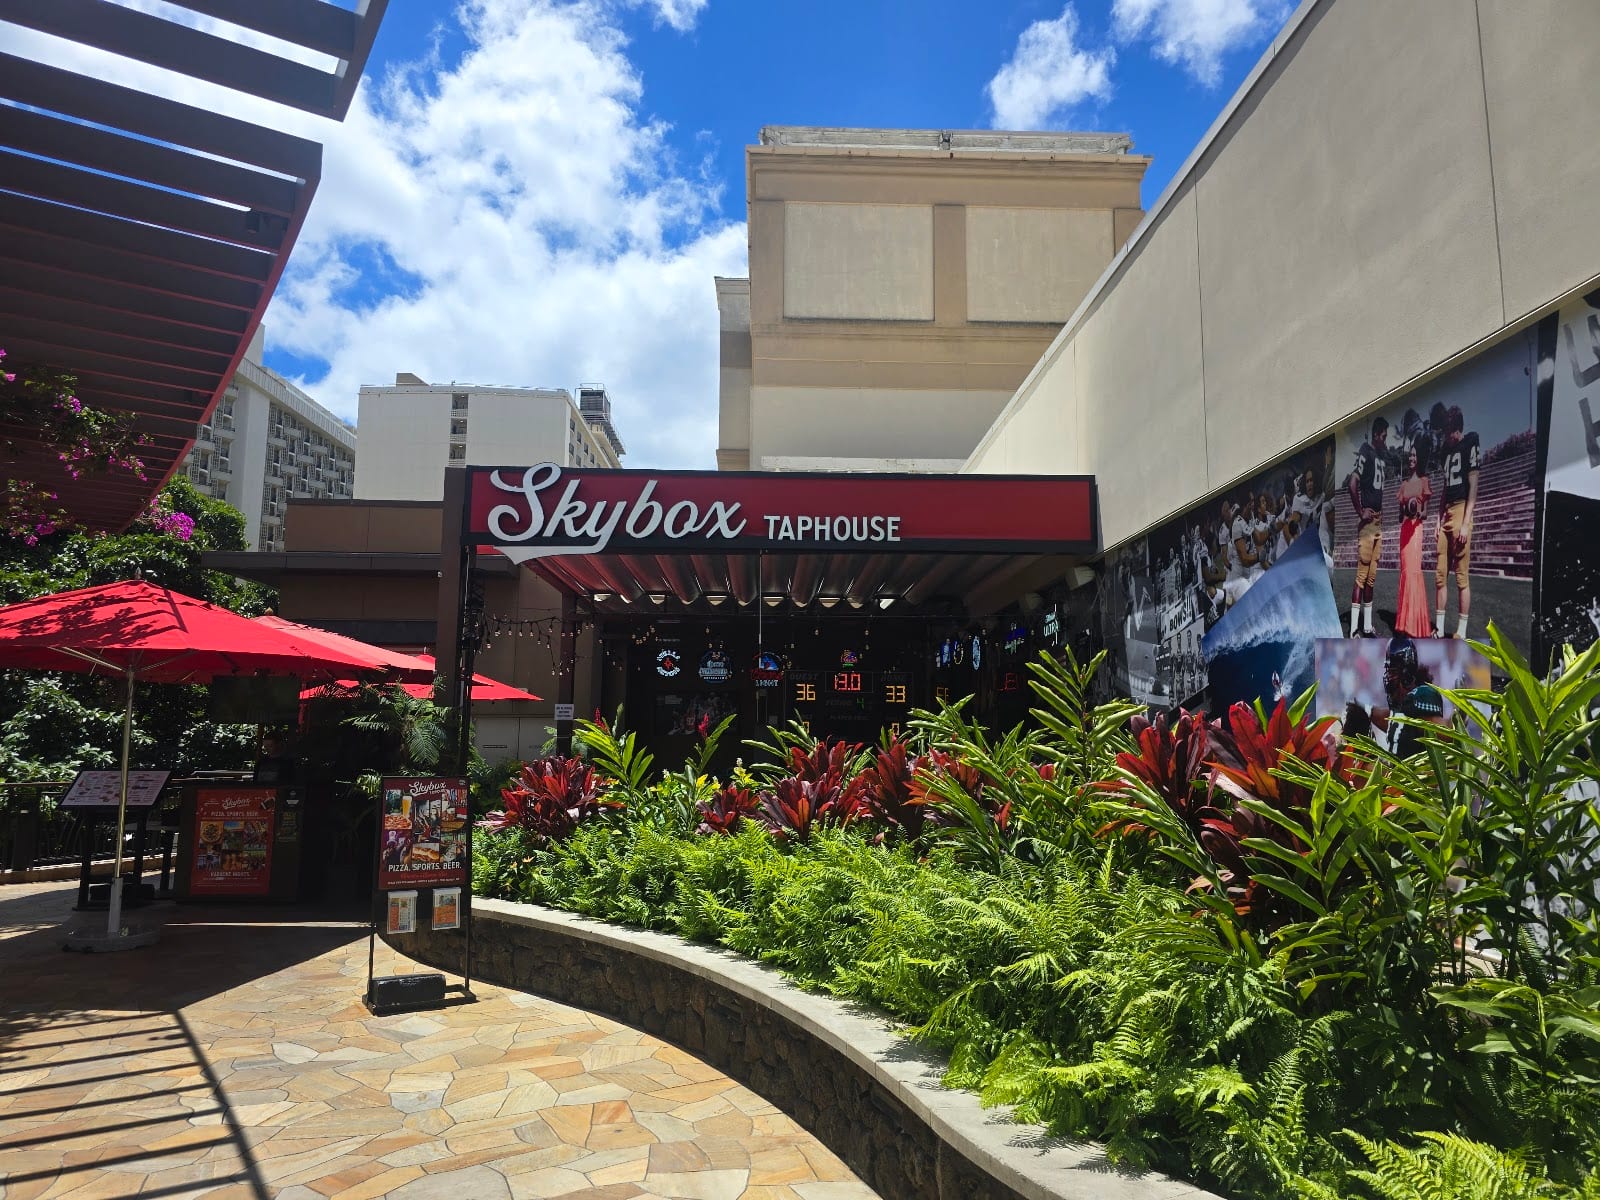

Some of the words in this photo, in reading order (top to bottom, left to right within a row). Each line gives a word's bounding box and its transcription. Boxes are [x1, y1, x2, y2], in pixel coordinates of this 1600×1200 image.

[487, 462, 747, 564] Skybox
[764, 515, 901, 543] TAPHOUSE
[1043, 619, 1060, 637] ULTRA
[796, 683, 816, 701] 36
[885, 685, 906, 703] 33
[409, 781, 447, 797] Skybox
[388, 864, 411, 872] PIZZA.
[443, 861, 462, 870] BEER.
